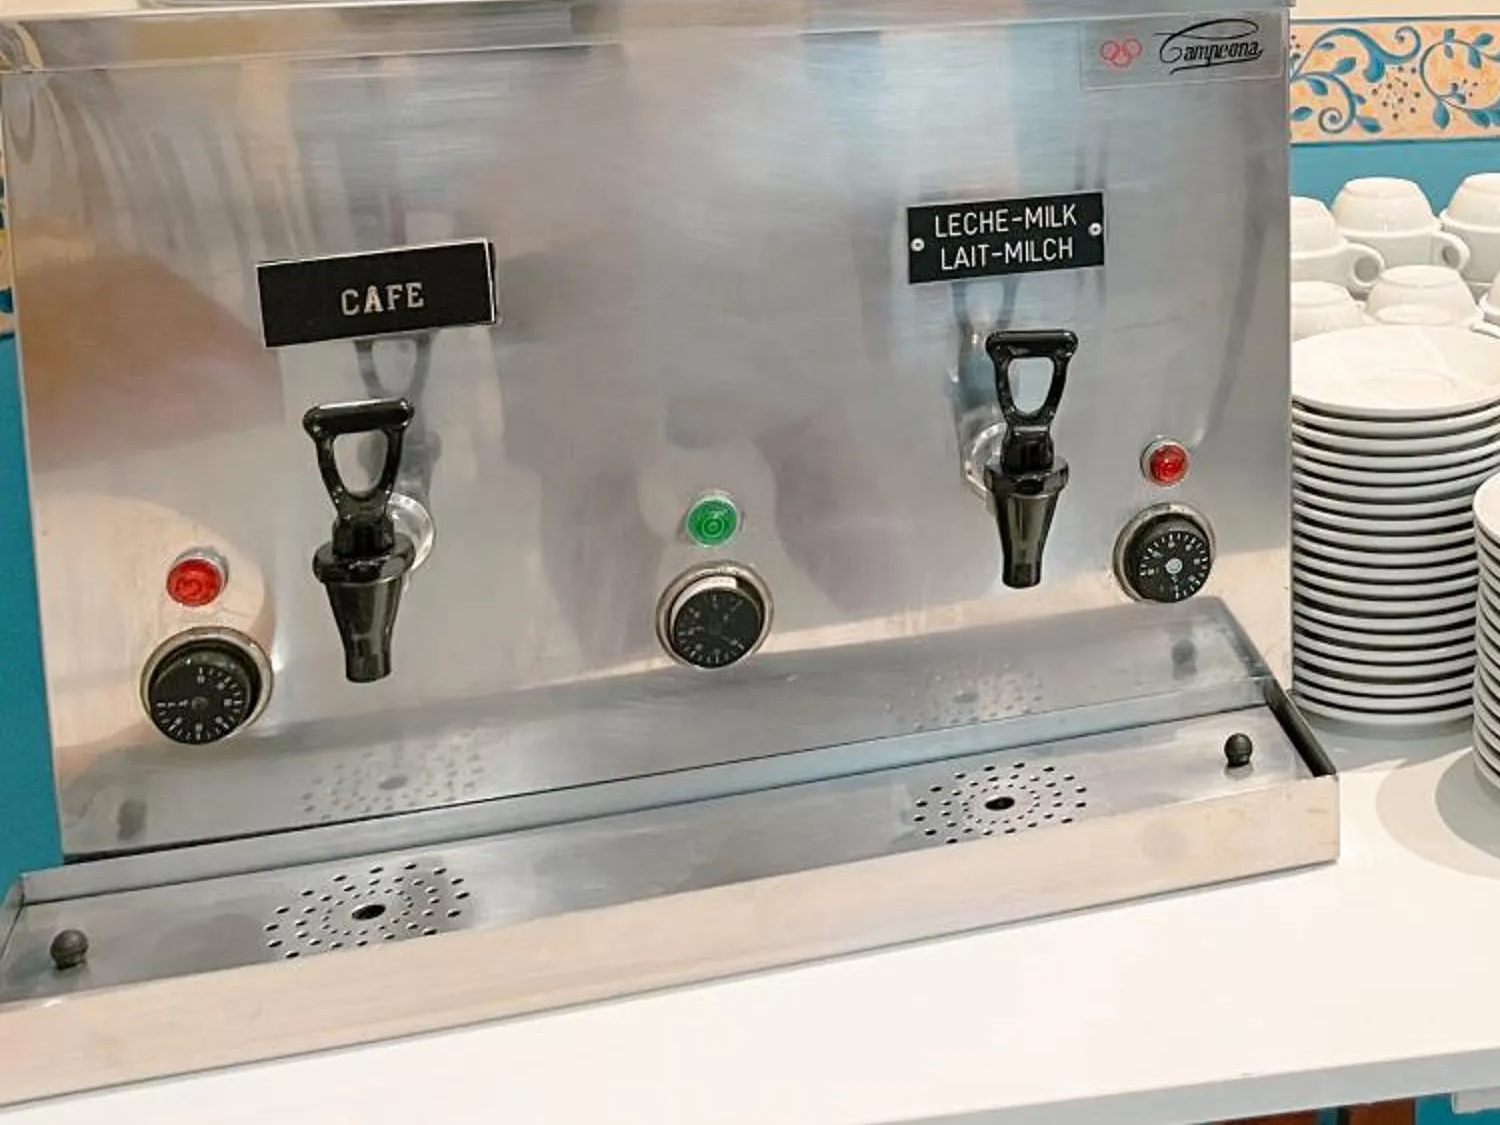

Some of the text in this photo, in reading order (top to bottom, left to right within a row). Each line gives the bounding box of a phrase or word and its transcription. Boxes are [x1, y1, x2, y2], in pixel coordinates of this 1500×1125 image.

[934, 202, 1078, 239] LECHE-MILK
[940, 236, 1073, 271] LAIT-MILCH
[340, 281, 424, 316] CAFE
